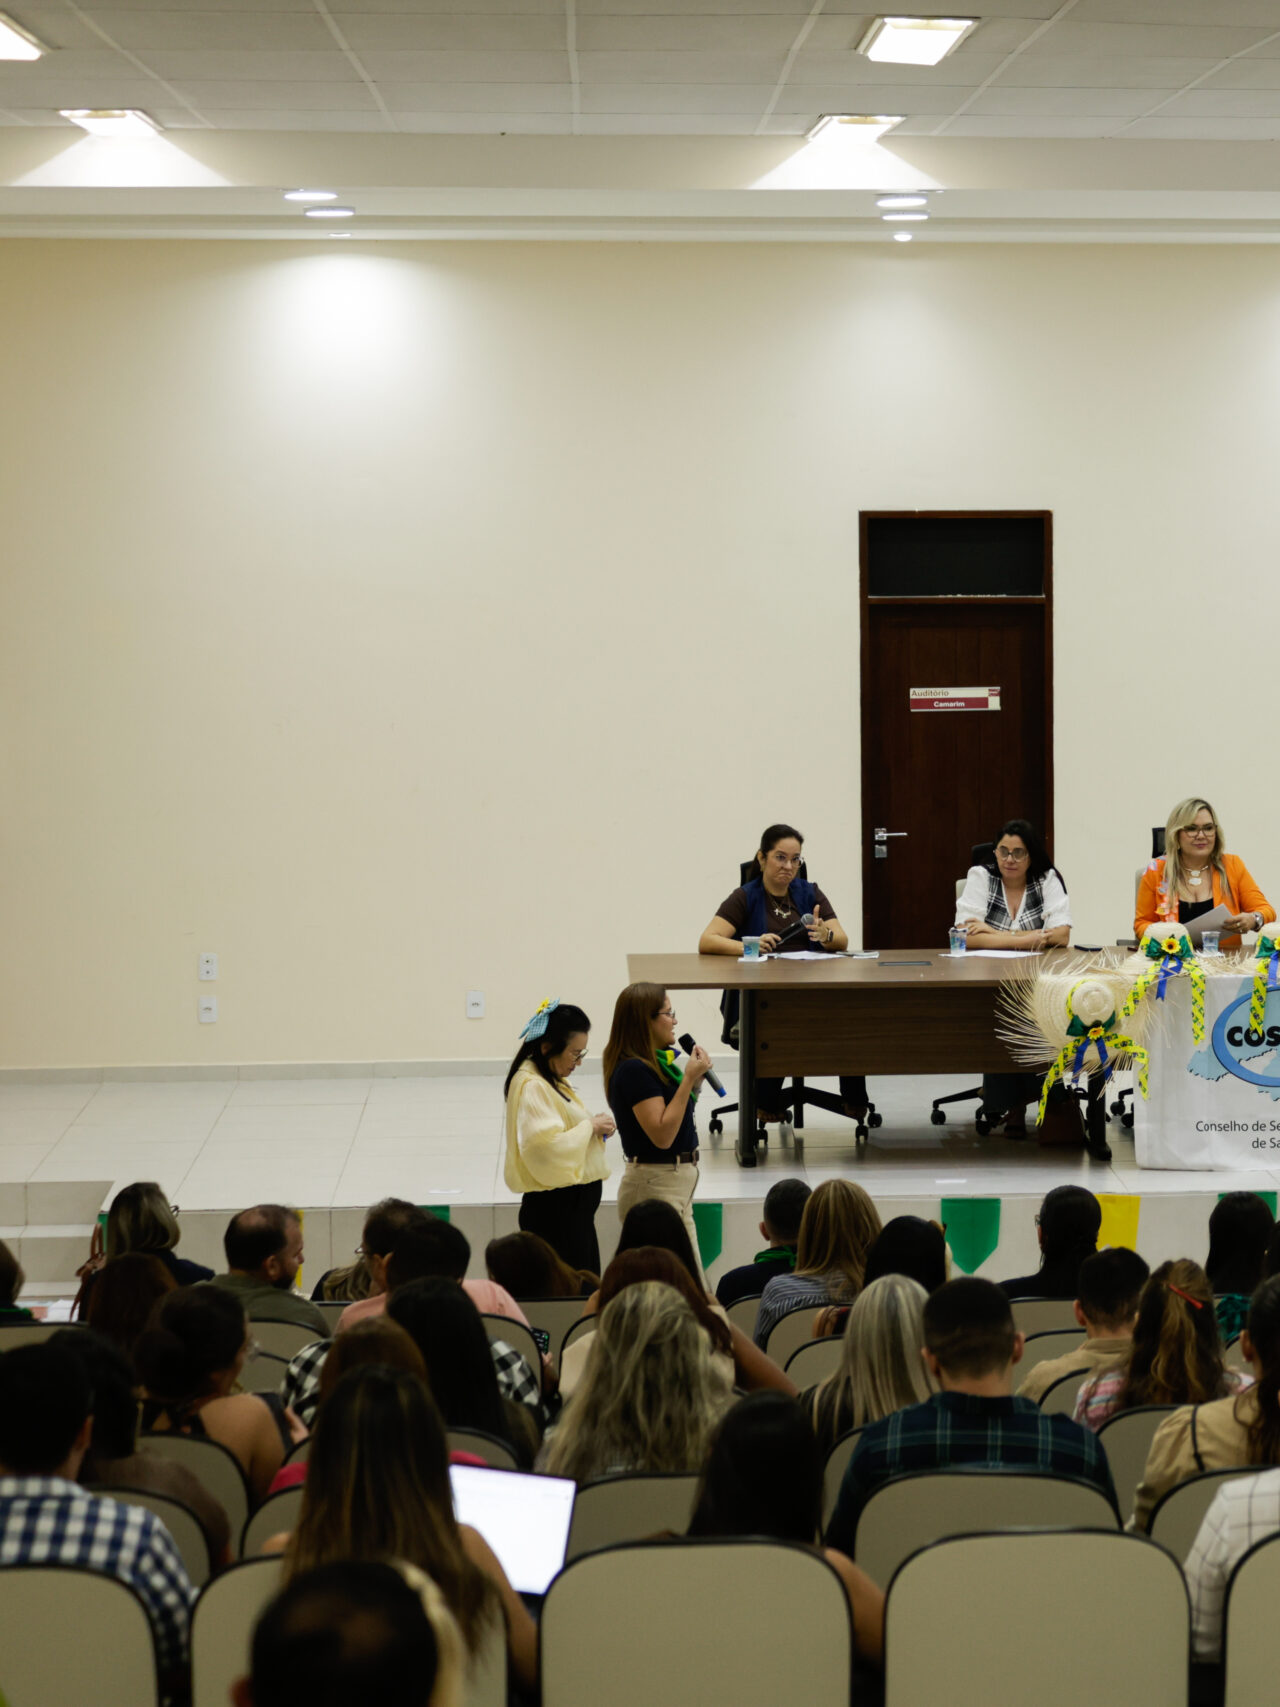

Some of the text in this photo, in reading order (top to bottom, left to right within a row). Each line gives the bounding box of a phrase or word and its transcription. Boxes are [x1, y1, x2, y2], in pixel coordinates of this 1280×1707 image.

[1195, 1120, 1249, 1132] Conselho
[1251, 1120, 1267, 1132] de
[1251, 1137, 1267, 1149] de
